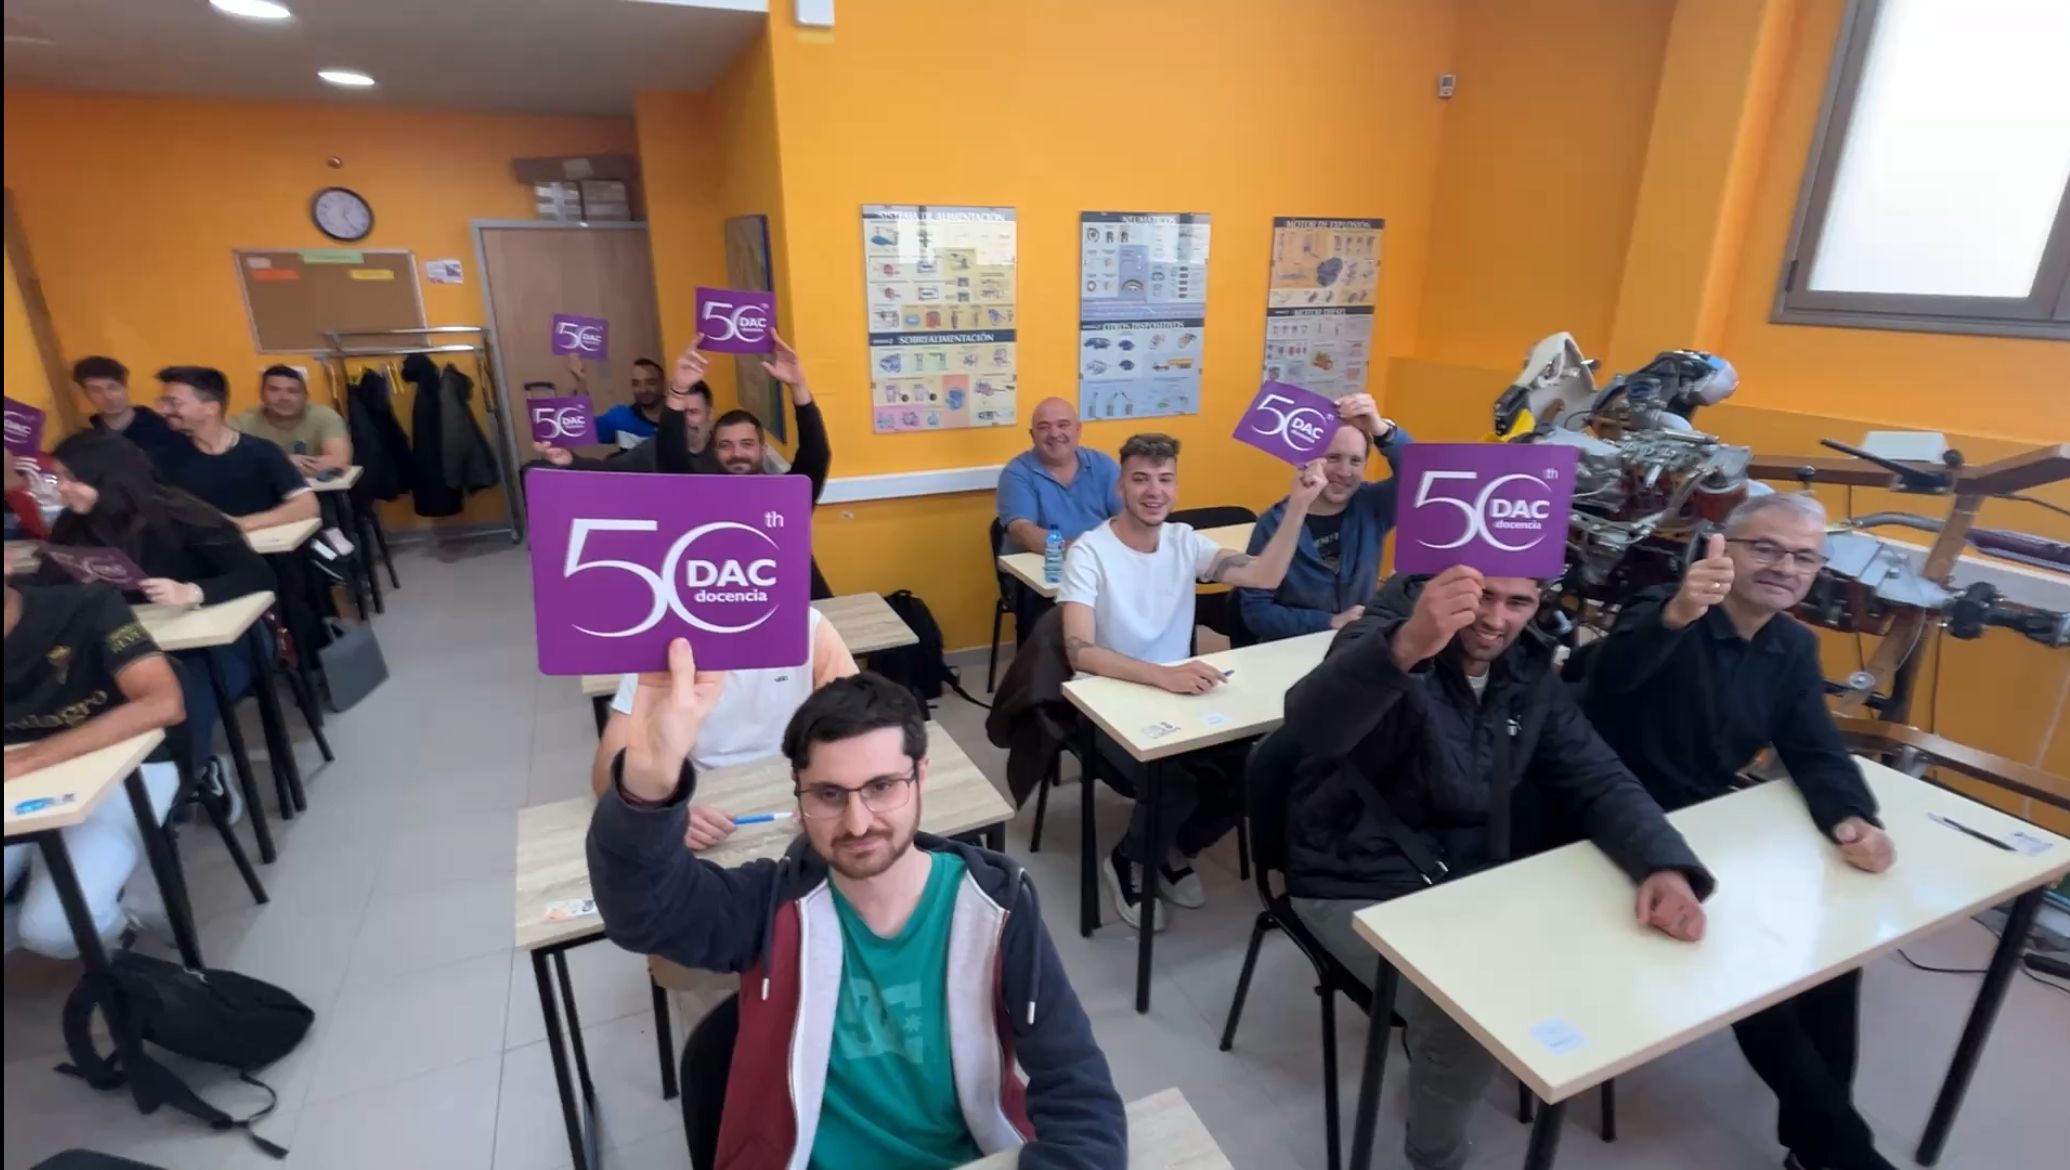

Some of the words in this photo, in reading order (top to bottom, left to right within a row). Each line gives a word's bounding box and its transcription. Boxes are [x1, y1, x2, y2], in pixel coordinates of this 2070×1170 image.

[740, 317, 767, 328] DAC
[562, 416, 586, 426] DAC
[1291, 417, 1324, 440] DAC
[1490, 498, 1551, 519] DAC
[1494, 520, 1542, 530] docencia
[686, 559, 777, 587] DAC
[694, 588, 768, 603] docencia
